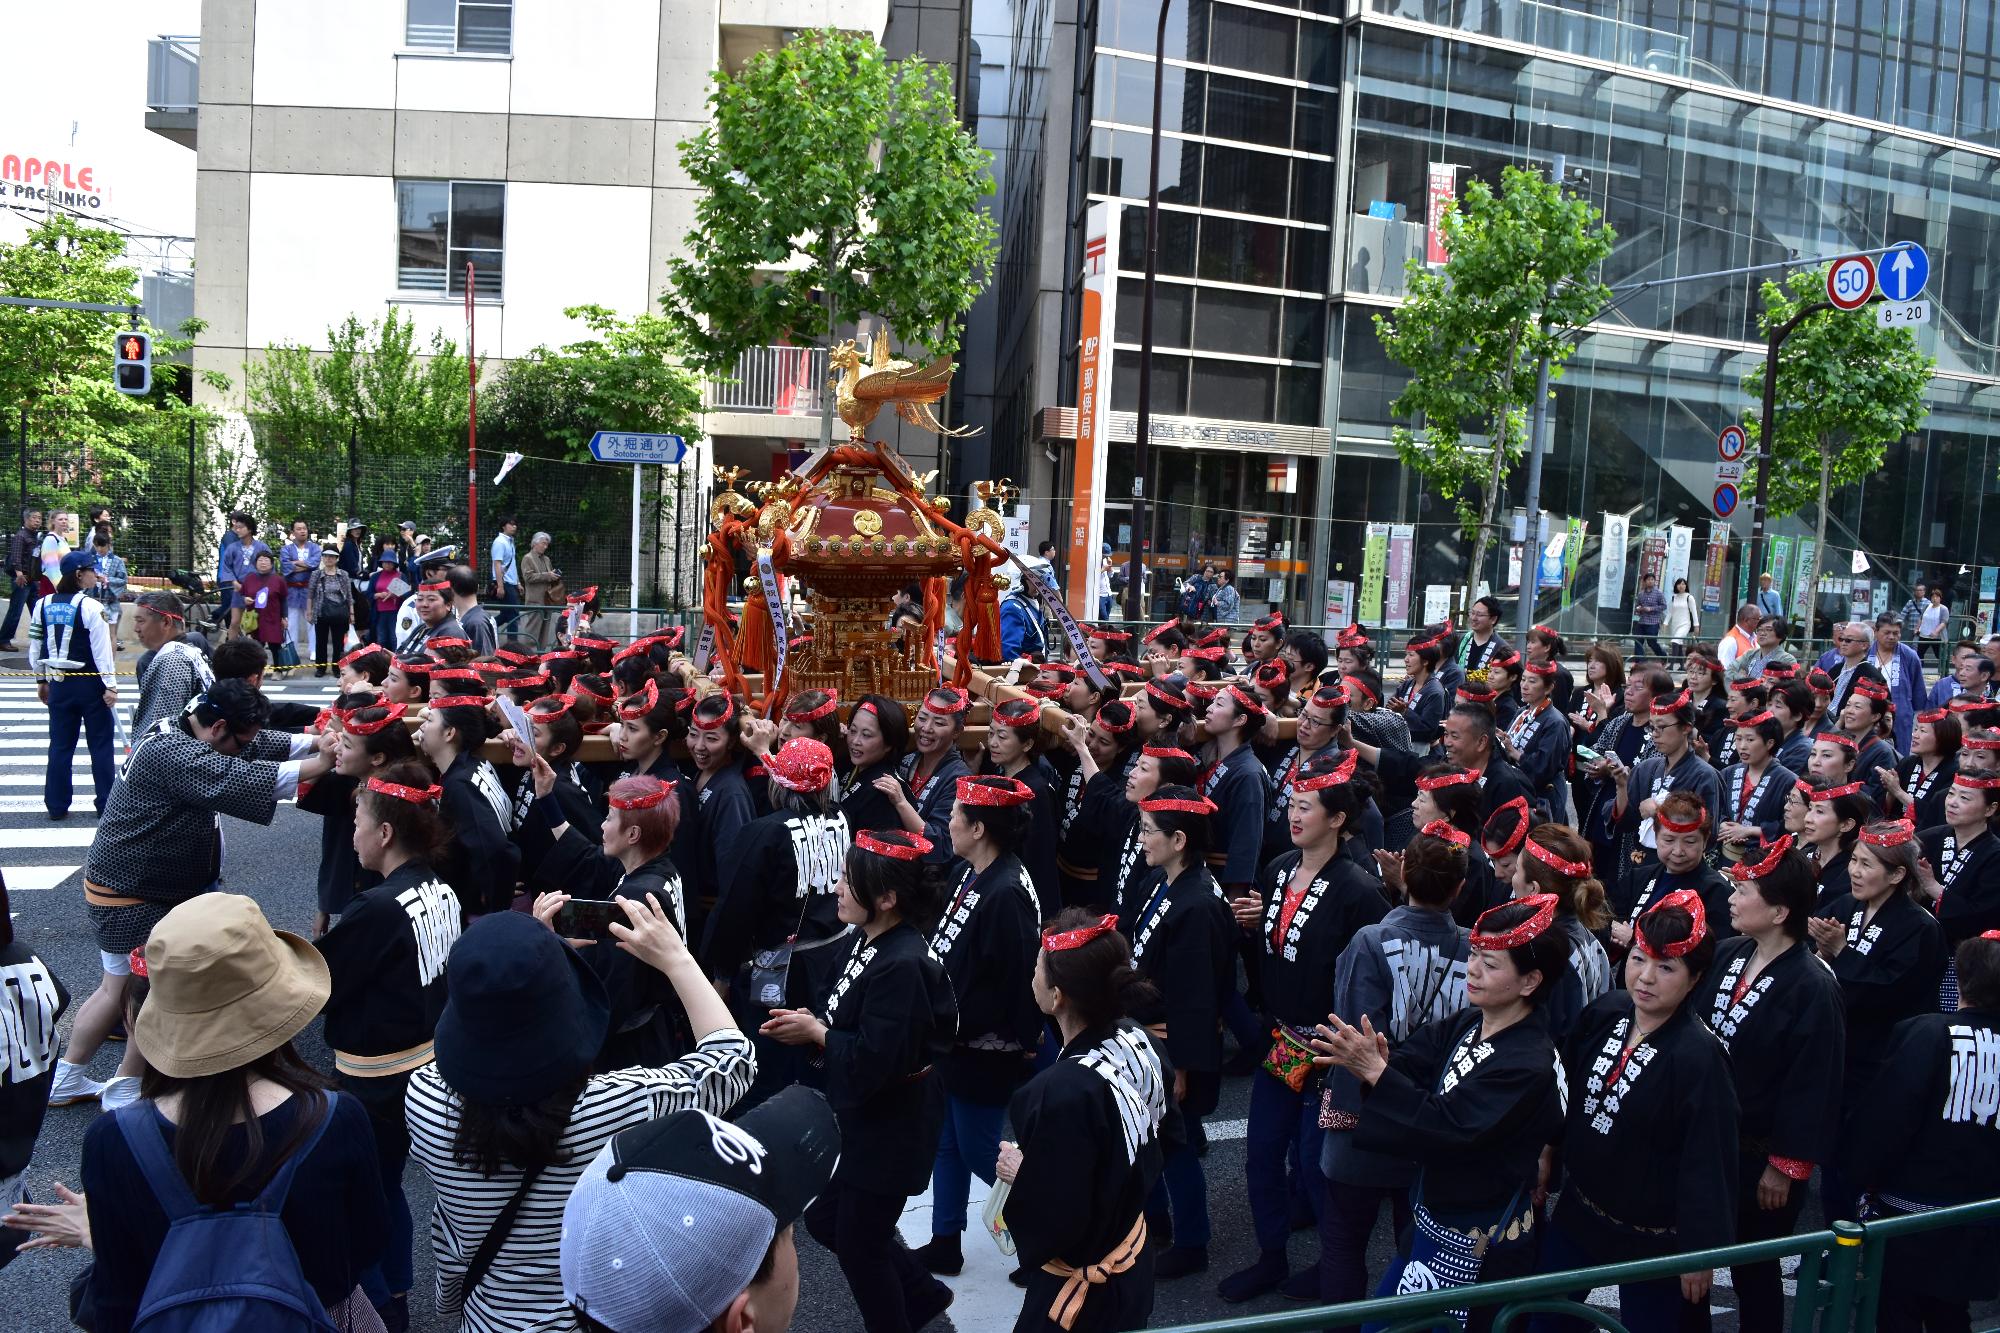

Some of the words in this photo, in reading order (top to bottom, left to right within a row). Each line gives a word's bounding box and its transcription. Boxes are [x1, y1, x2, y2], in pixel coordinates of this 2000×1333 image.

[14, 184, 101, 208] PACINKO
[1838, 268, 1864, 294] 50
[1081, 367, 1094, 439] 郵便局
[608, 436, 669, 452] 外堀通り
[1125, 418, 1176, 438] KNDA
[1182, 423, 1221, 441] POST
[1227, 428, 1277, 445] OFFICE
[613, 450, 664, 459] Sotobori-dori
[45, 604, 73, 615] POLICE
[1283, 878, 1330, 963] 須田町中部
[1583, 1017, 1630, 1115] 須田町中部
[1590, 1042, 1658, 1136] 須田町中部
